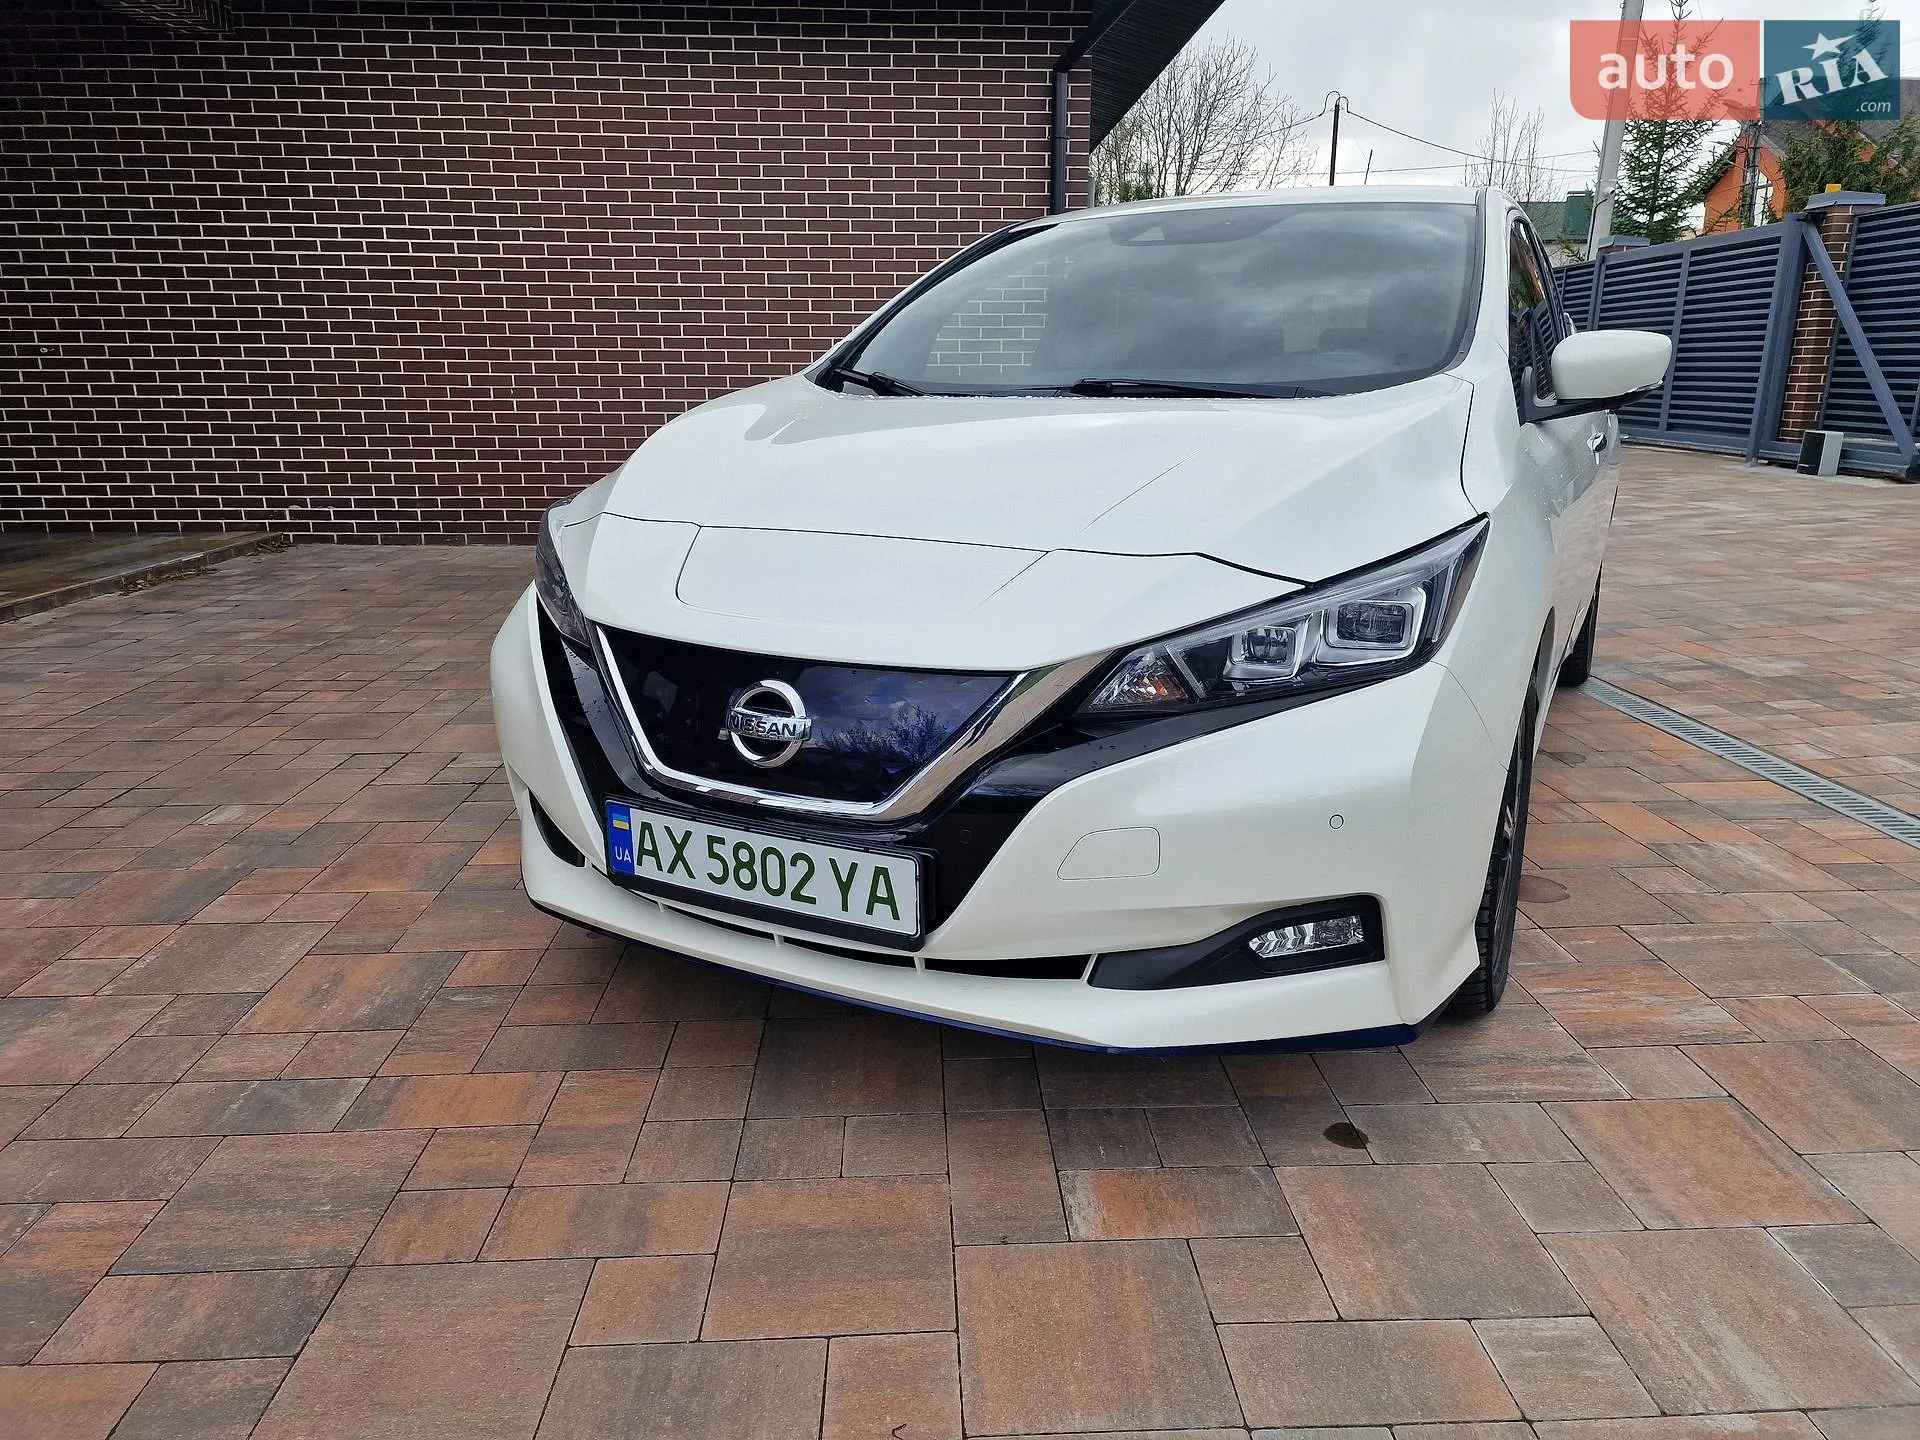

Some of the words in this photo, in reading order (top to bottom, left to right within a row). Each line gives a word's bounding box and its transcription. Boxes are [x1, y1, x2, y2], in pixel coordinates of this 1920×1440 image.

[728, 712, 797, 737] NISSAN
[615, 848, 632, 864] UA
[636, 821, 696, 880] AX
[706, 834, 817, 905] 5802
[828, 857, 901, 921] YA
